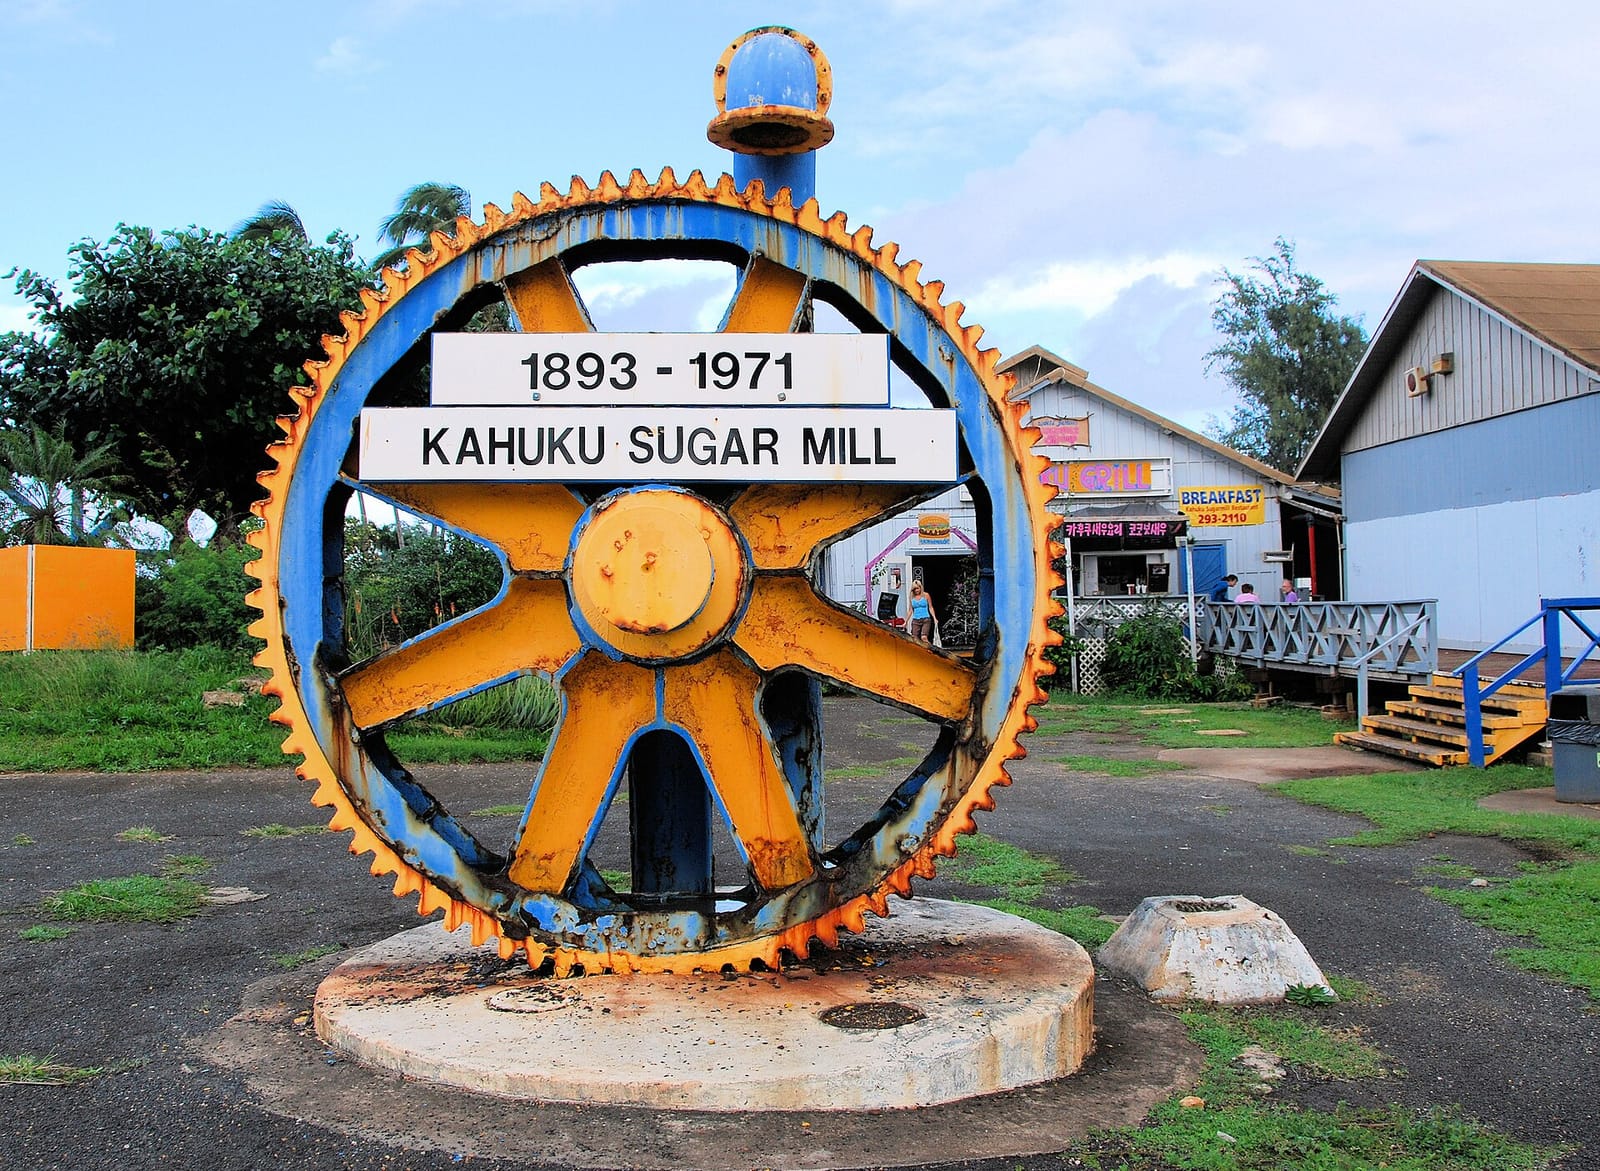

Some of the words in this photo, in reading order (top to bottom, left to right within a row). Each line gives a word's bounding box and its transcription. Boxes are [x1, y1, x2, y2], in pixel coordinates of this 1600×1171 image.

[521, 352, 638, 391] 1893
[688, 351, 793, 390] 1971
[421, 426, 605, 466] KAHUKU
[628, 425, 779, 465] SUGAR
[802, 427, 897, 465] MILL
[1080, 463, 1151, 492] GRILL
[1181, 488, 1262, 505] BREAKFAST
[1065, 522, 1122, 537] 카후쿠새우요리
[1128, 522, 1168, 537] 코코넛새우
[1198, 512, 1247, 524] 293-2110
